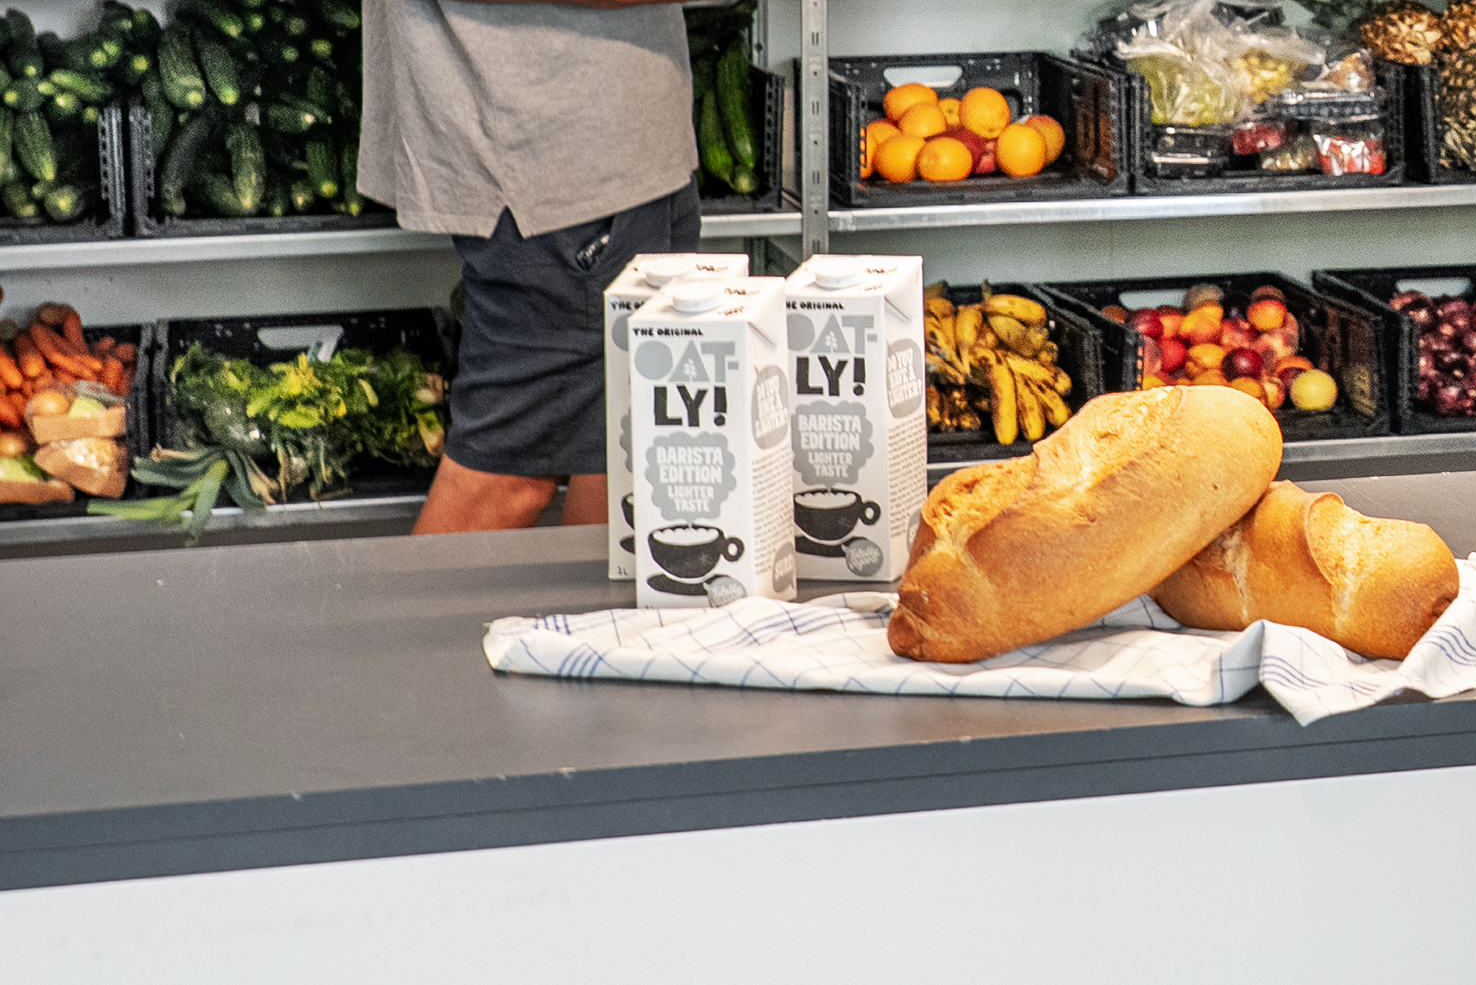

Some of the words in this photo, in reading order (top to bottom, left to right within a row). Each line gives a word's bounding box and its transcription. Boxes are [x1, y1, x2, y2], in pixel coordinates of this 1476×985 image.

[610, 302, 631, 311] THE
[785, 301, 798, 310] HE
[799, 301, 845, 311] ORIGINAL
[632, 327, 654, 336] THE
[656, 327, 704, 337] ORIGINAL
[634, 339, 739, 383] OAT-
[796, 355, 866, 397] LY!
[653, 383, 727, 427] LY!
[797, 413, 863, 434] BARISTA
[800, 432, 861, 451] EDITION
[656, 445, 724, 466] BARISTA
[808, 451, 853, 466] LIGHTER
[659, 464, 722, 485] EDITION
[814, 464, 849, 478] TASTE
[667, 484, 715, 500] LIGHTER
[674, 498, 711, 513] TASTE
